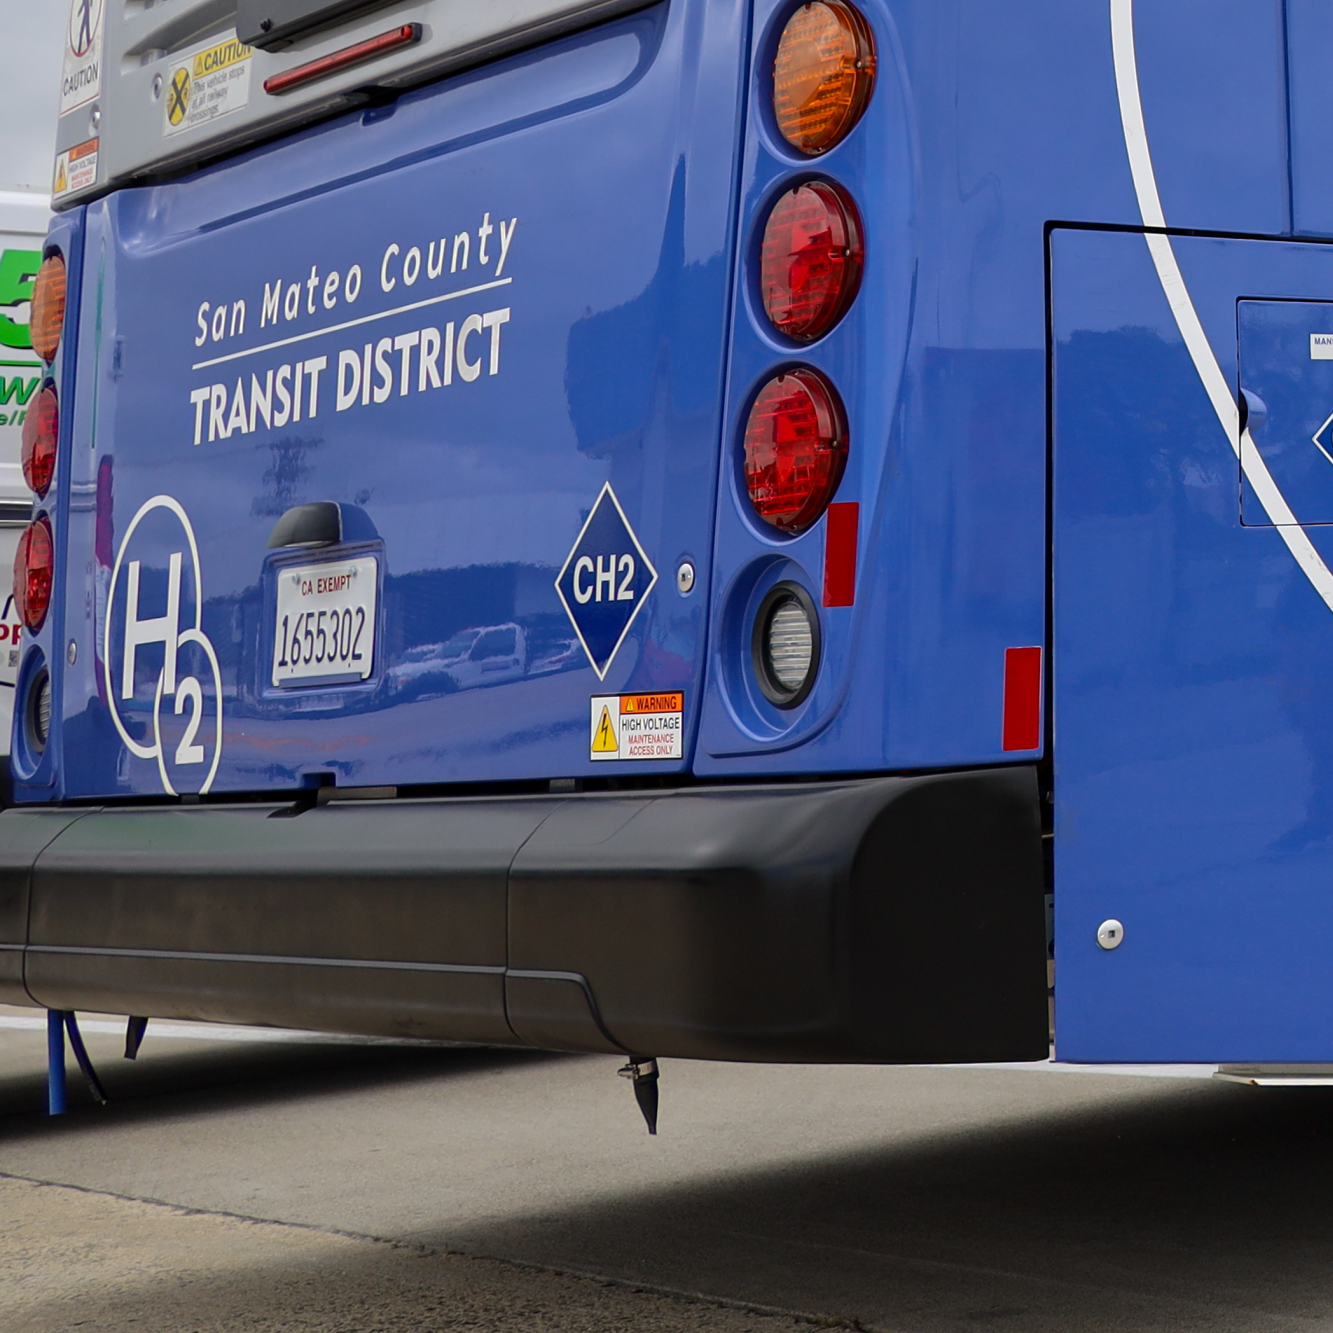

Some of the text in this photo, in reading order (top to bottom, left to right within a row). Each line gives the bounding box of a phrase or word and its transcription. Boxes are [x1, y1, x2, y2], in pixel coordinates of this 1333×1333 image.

[204, 41, 251, 71] CAUTION
[63, 62, 99, 96] CAUTION
[194, 212, 517, 347] San Mateo County
[190, 307, 511, 446] TRANSIT DISTRICT
[301, 574, 351, 596] CA EXEMPT
[572, 553, 635, 604] CH2
[278, 606, 365, 667] 1655302
[636, 696, 677, 710] WARNING
[622, 717, 680, 731] HIGH VOLTAGE
[628, 733, 674, 744] MAINTENANCE
[629, 745, 673, 755] ACCESS ONLY
